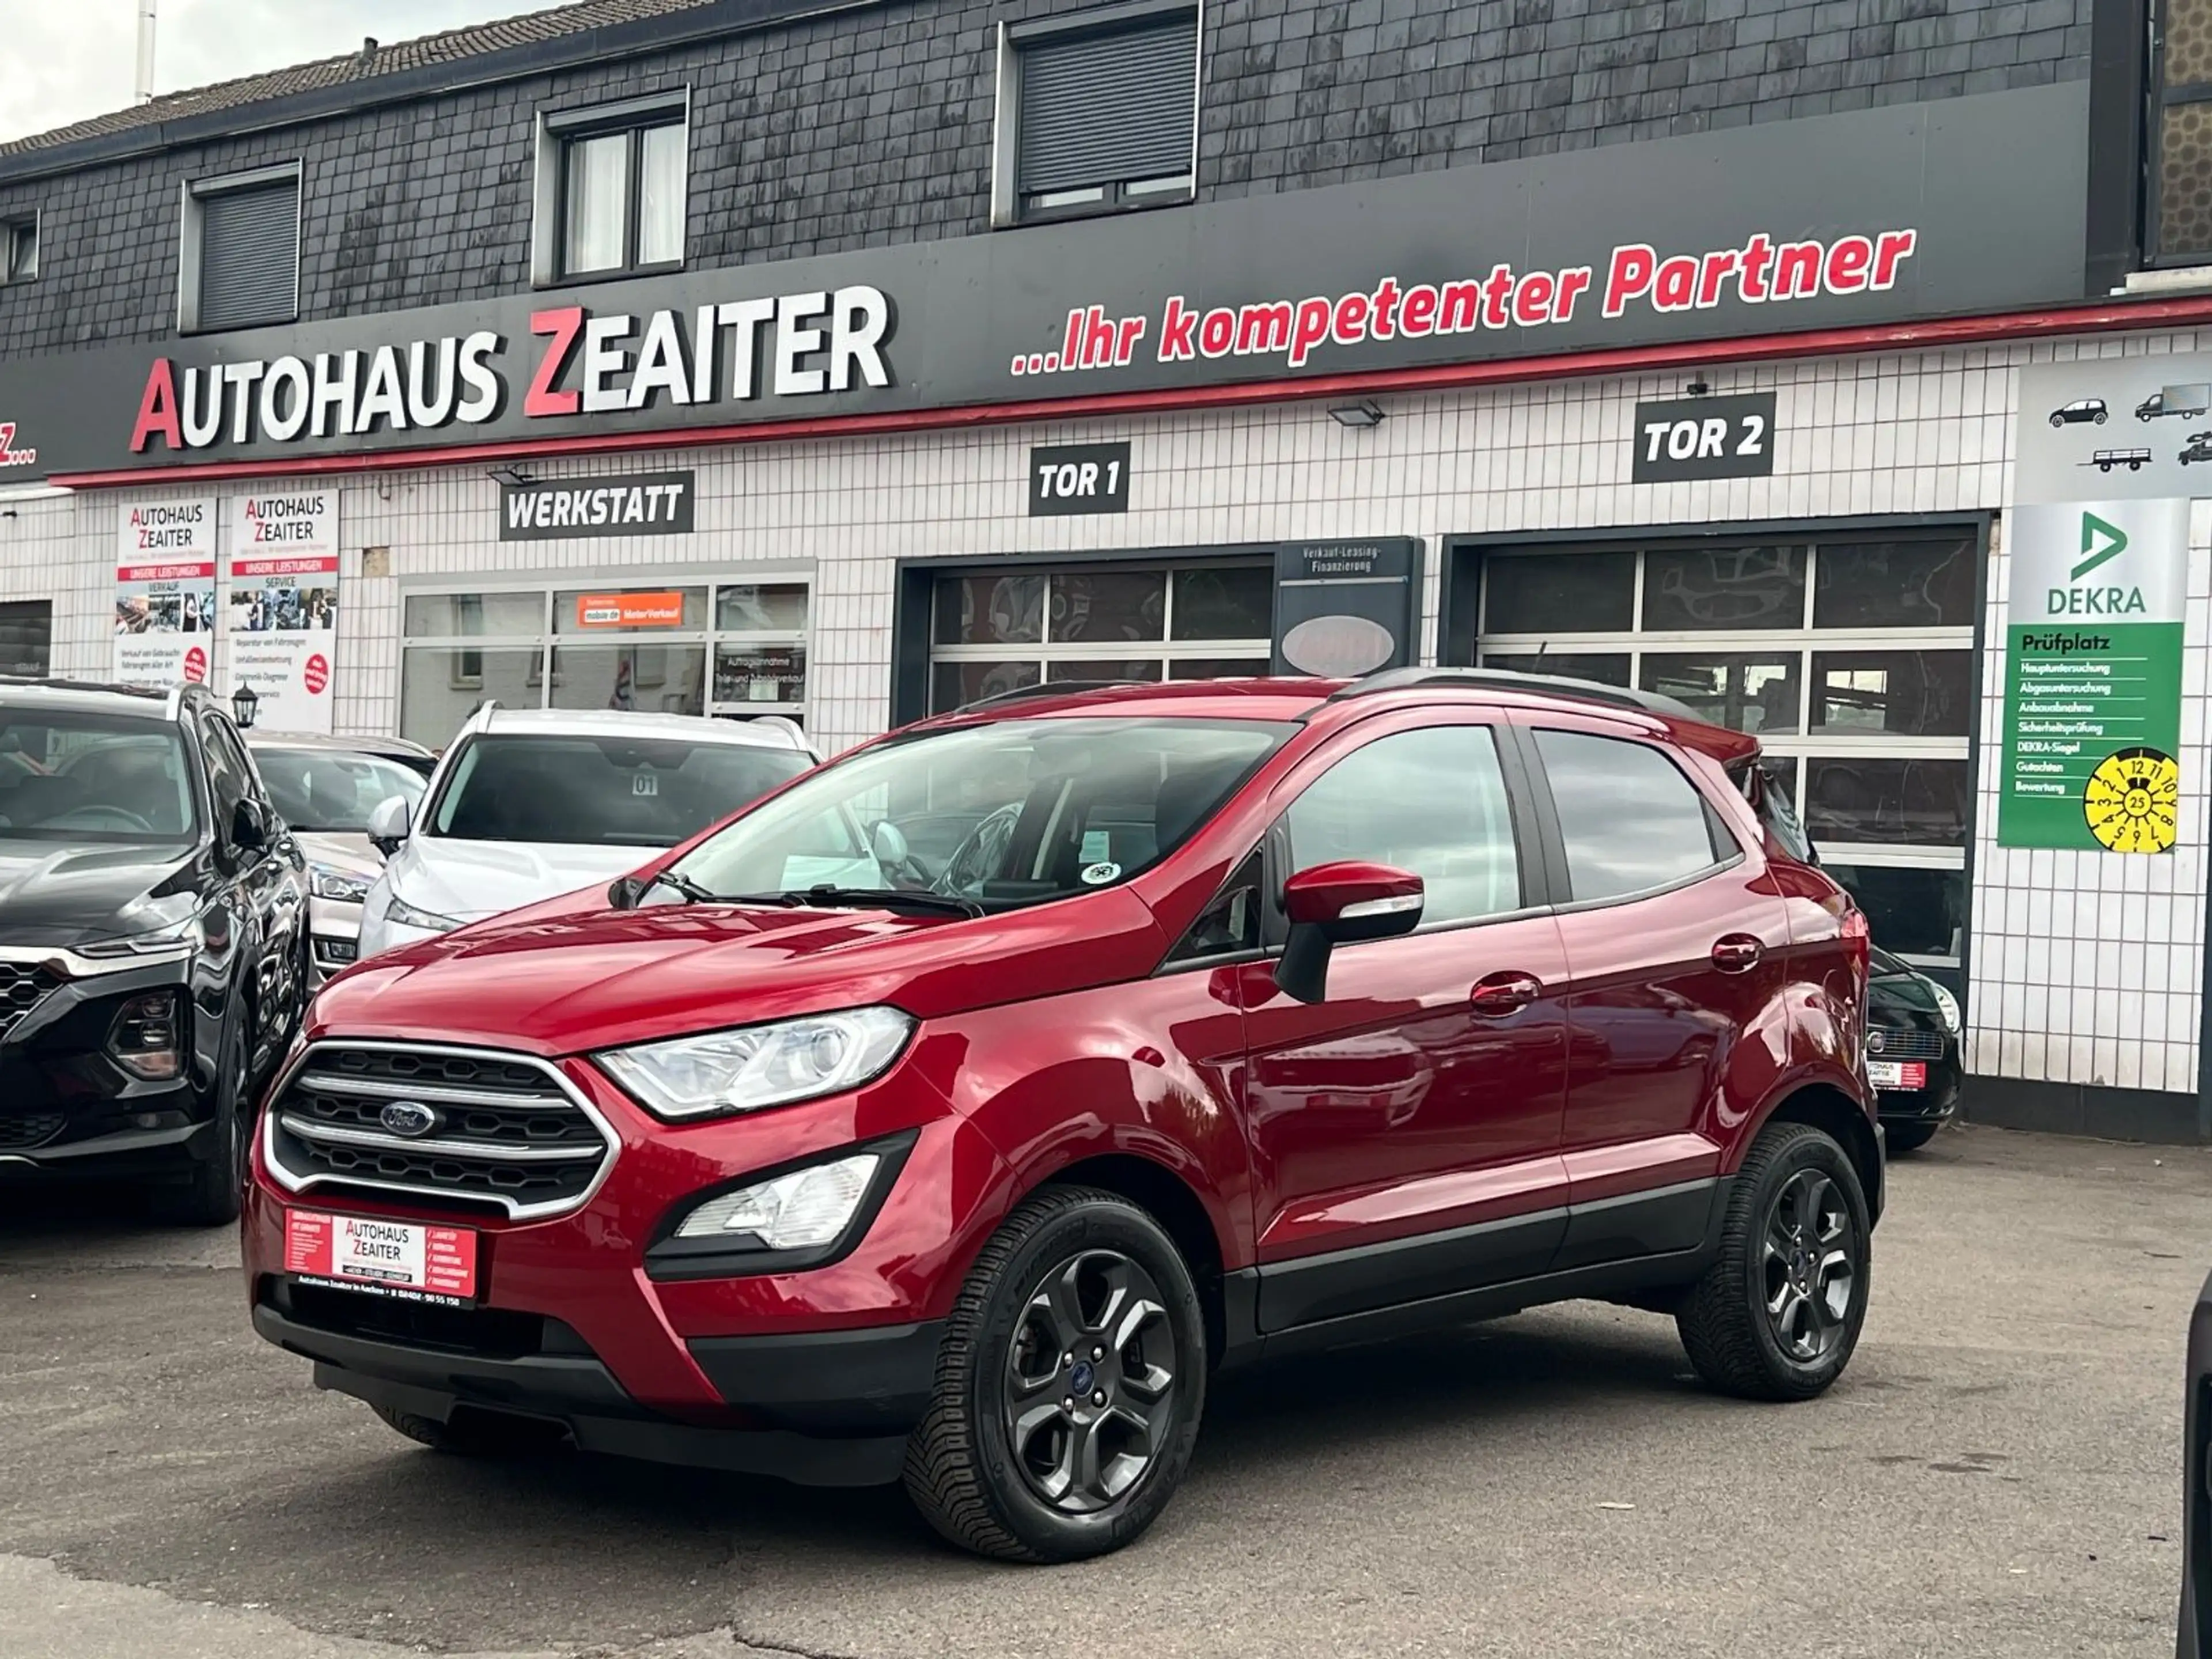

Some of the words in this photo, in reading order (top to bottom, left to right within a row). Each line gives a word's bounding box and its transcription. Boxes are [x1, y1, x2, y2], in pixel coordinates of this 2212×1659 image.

[1011, 304, 1146, 375] ...Ihr
[1157, 264, 1592, 367] kompetenter
[1602, 229, 1916, 319] Partner
[128, 331, 502, 451] AUTOHAUS
[524, 285, 892, 416] ZEAITER
[1645, 418, 1727, 461] TOR
[1736, 415, 1764, 455] 2
[1039, 463, 1099, 498] TOR
[1107, 461, 1120, 494] 1
[245, 496, 324, 518] AUTOHAUS
[509, 484, 684, 528] WERKSTATT
[131, 505, 202, 527] AUTOHAUS
[139, 528, 192, 548] ZEAITER
[255, 521, 313, 541] ZEAITER
[276, 560, 323, 572] LEISTUNGEN
[1312, 561, 1371, 572] Finanzierung
[149, 581, 180, 592] VERKAUF
[266, 576, 296, 588] SERVICE
[2047, 586, 2146, 615] DEKRA
[2022, 632, 2111, 654] Prüfplatz
[2021, 661, 2110, 675] Hauptuntersuchung
[2020, 681, 2111, 695] Abgasuntersuchung
[2018, 721, 2104, 736] Sicherheitsprüfung
[2017, 741, 2081, 755] DEKRA-Siegel
[2016, 761, 2064, 772] Gutachten
[2116, 767, 2126, 780] 1
[2131, 760, 2144, 774] 12
[2149, 763, 2163, 780] 11
[636, 776, 654, 794] 01
[2015, 781, 2065, 794] Bewertung
[2103, 779, 2116, 792] 2
[2161, 777, 2177, 794] 10
[2097, 798, 2112, 807] 3
[2129, 797, 2145, 809] 25
[2101, 814, 2115, 824] 4
[2160, 815, 2174, 826] 8
[2114, 826, 2126, 839] 5
[2133, 830, 2141, 843] 6
[2151, 825, 2159, 840] 7
[346, 1220, 409, 1243] AUTOHAUS
[354, 1239, 401, 1260] ZEAITER
